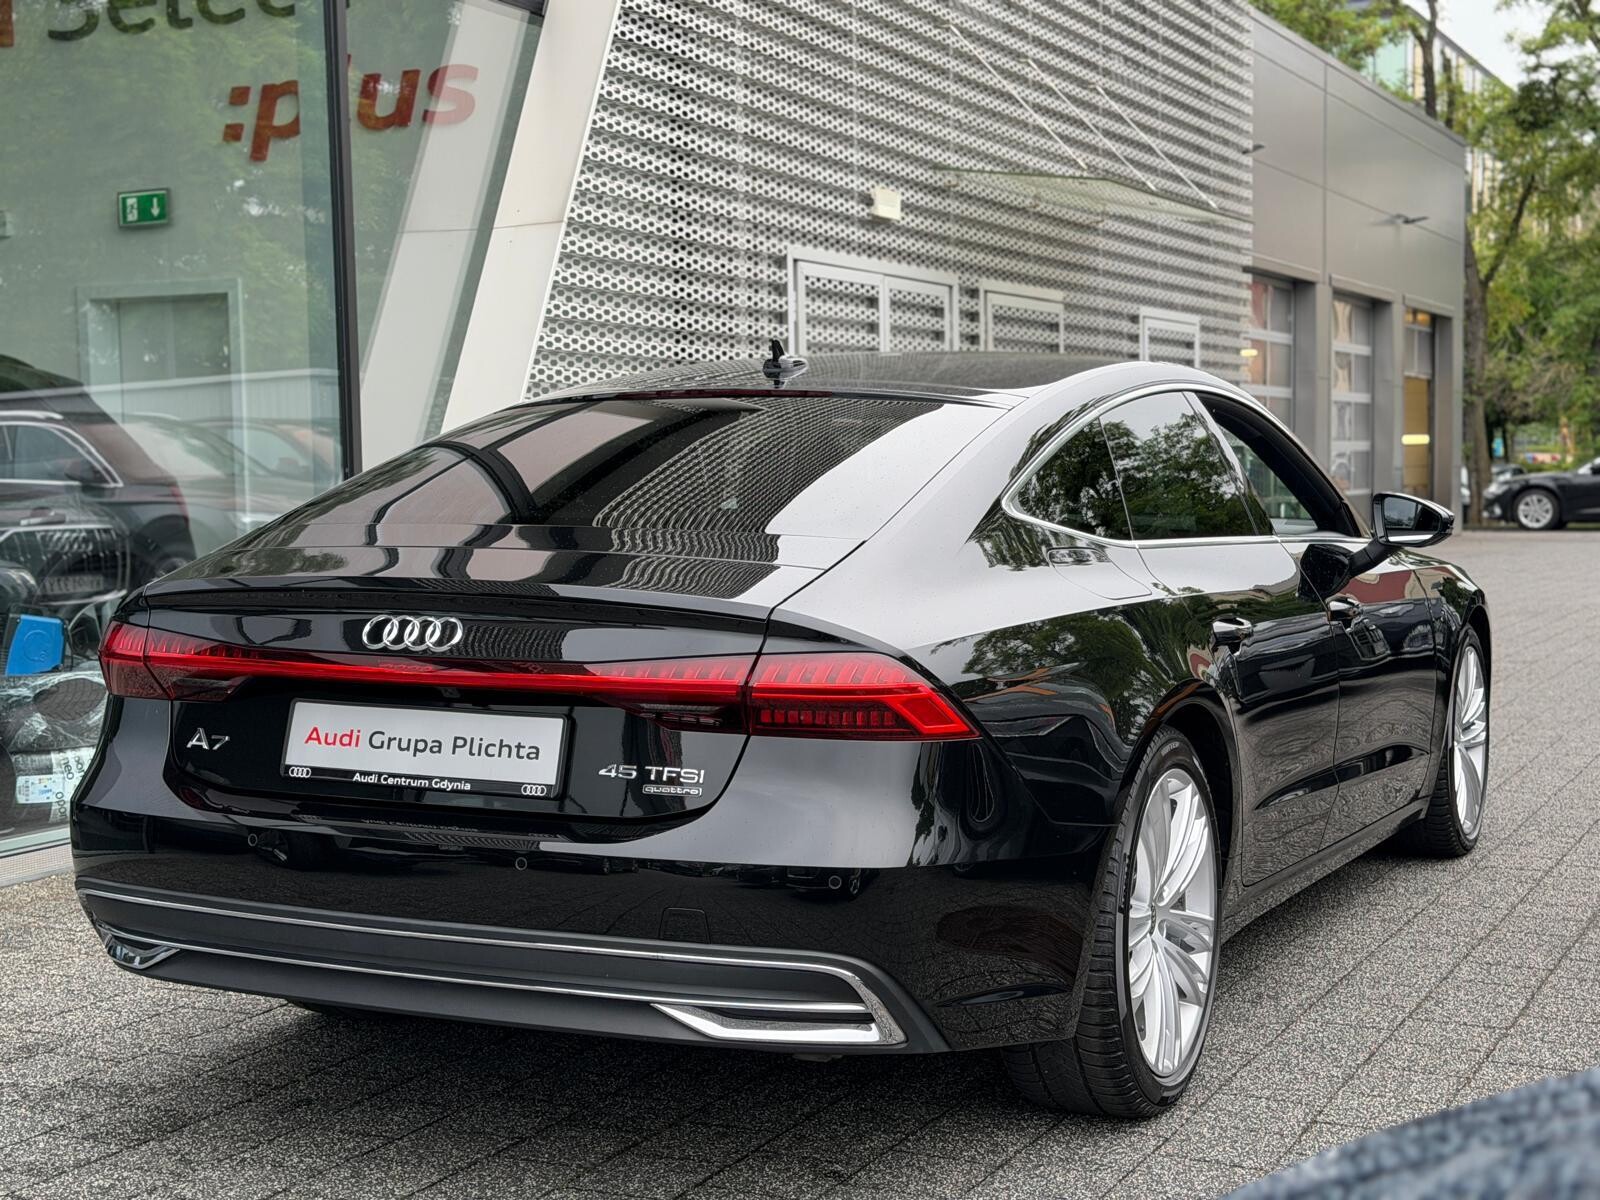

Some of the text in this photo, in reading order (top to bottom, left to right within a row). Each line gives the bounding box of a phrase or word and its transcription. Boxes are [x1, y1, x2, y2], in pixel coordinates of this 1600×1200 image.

[223, 54, 479, 161] :pus
[186, 727, 230, 750] A7
[304, 726, 540, 760] Audi Grupa Plichta
[352, 772, 471, 791] Audi Centrum Gdynia
[598, 764, 705, 783] 45 TFSI
[644, 785, 700, 796] quattro
